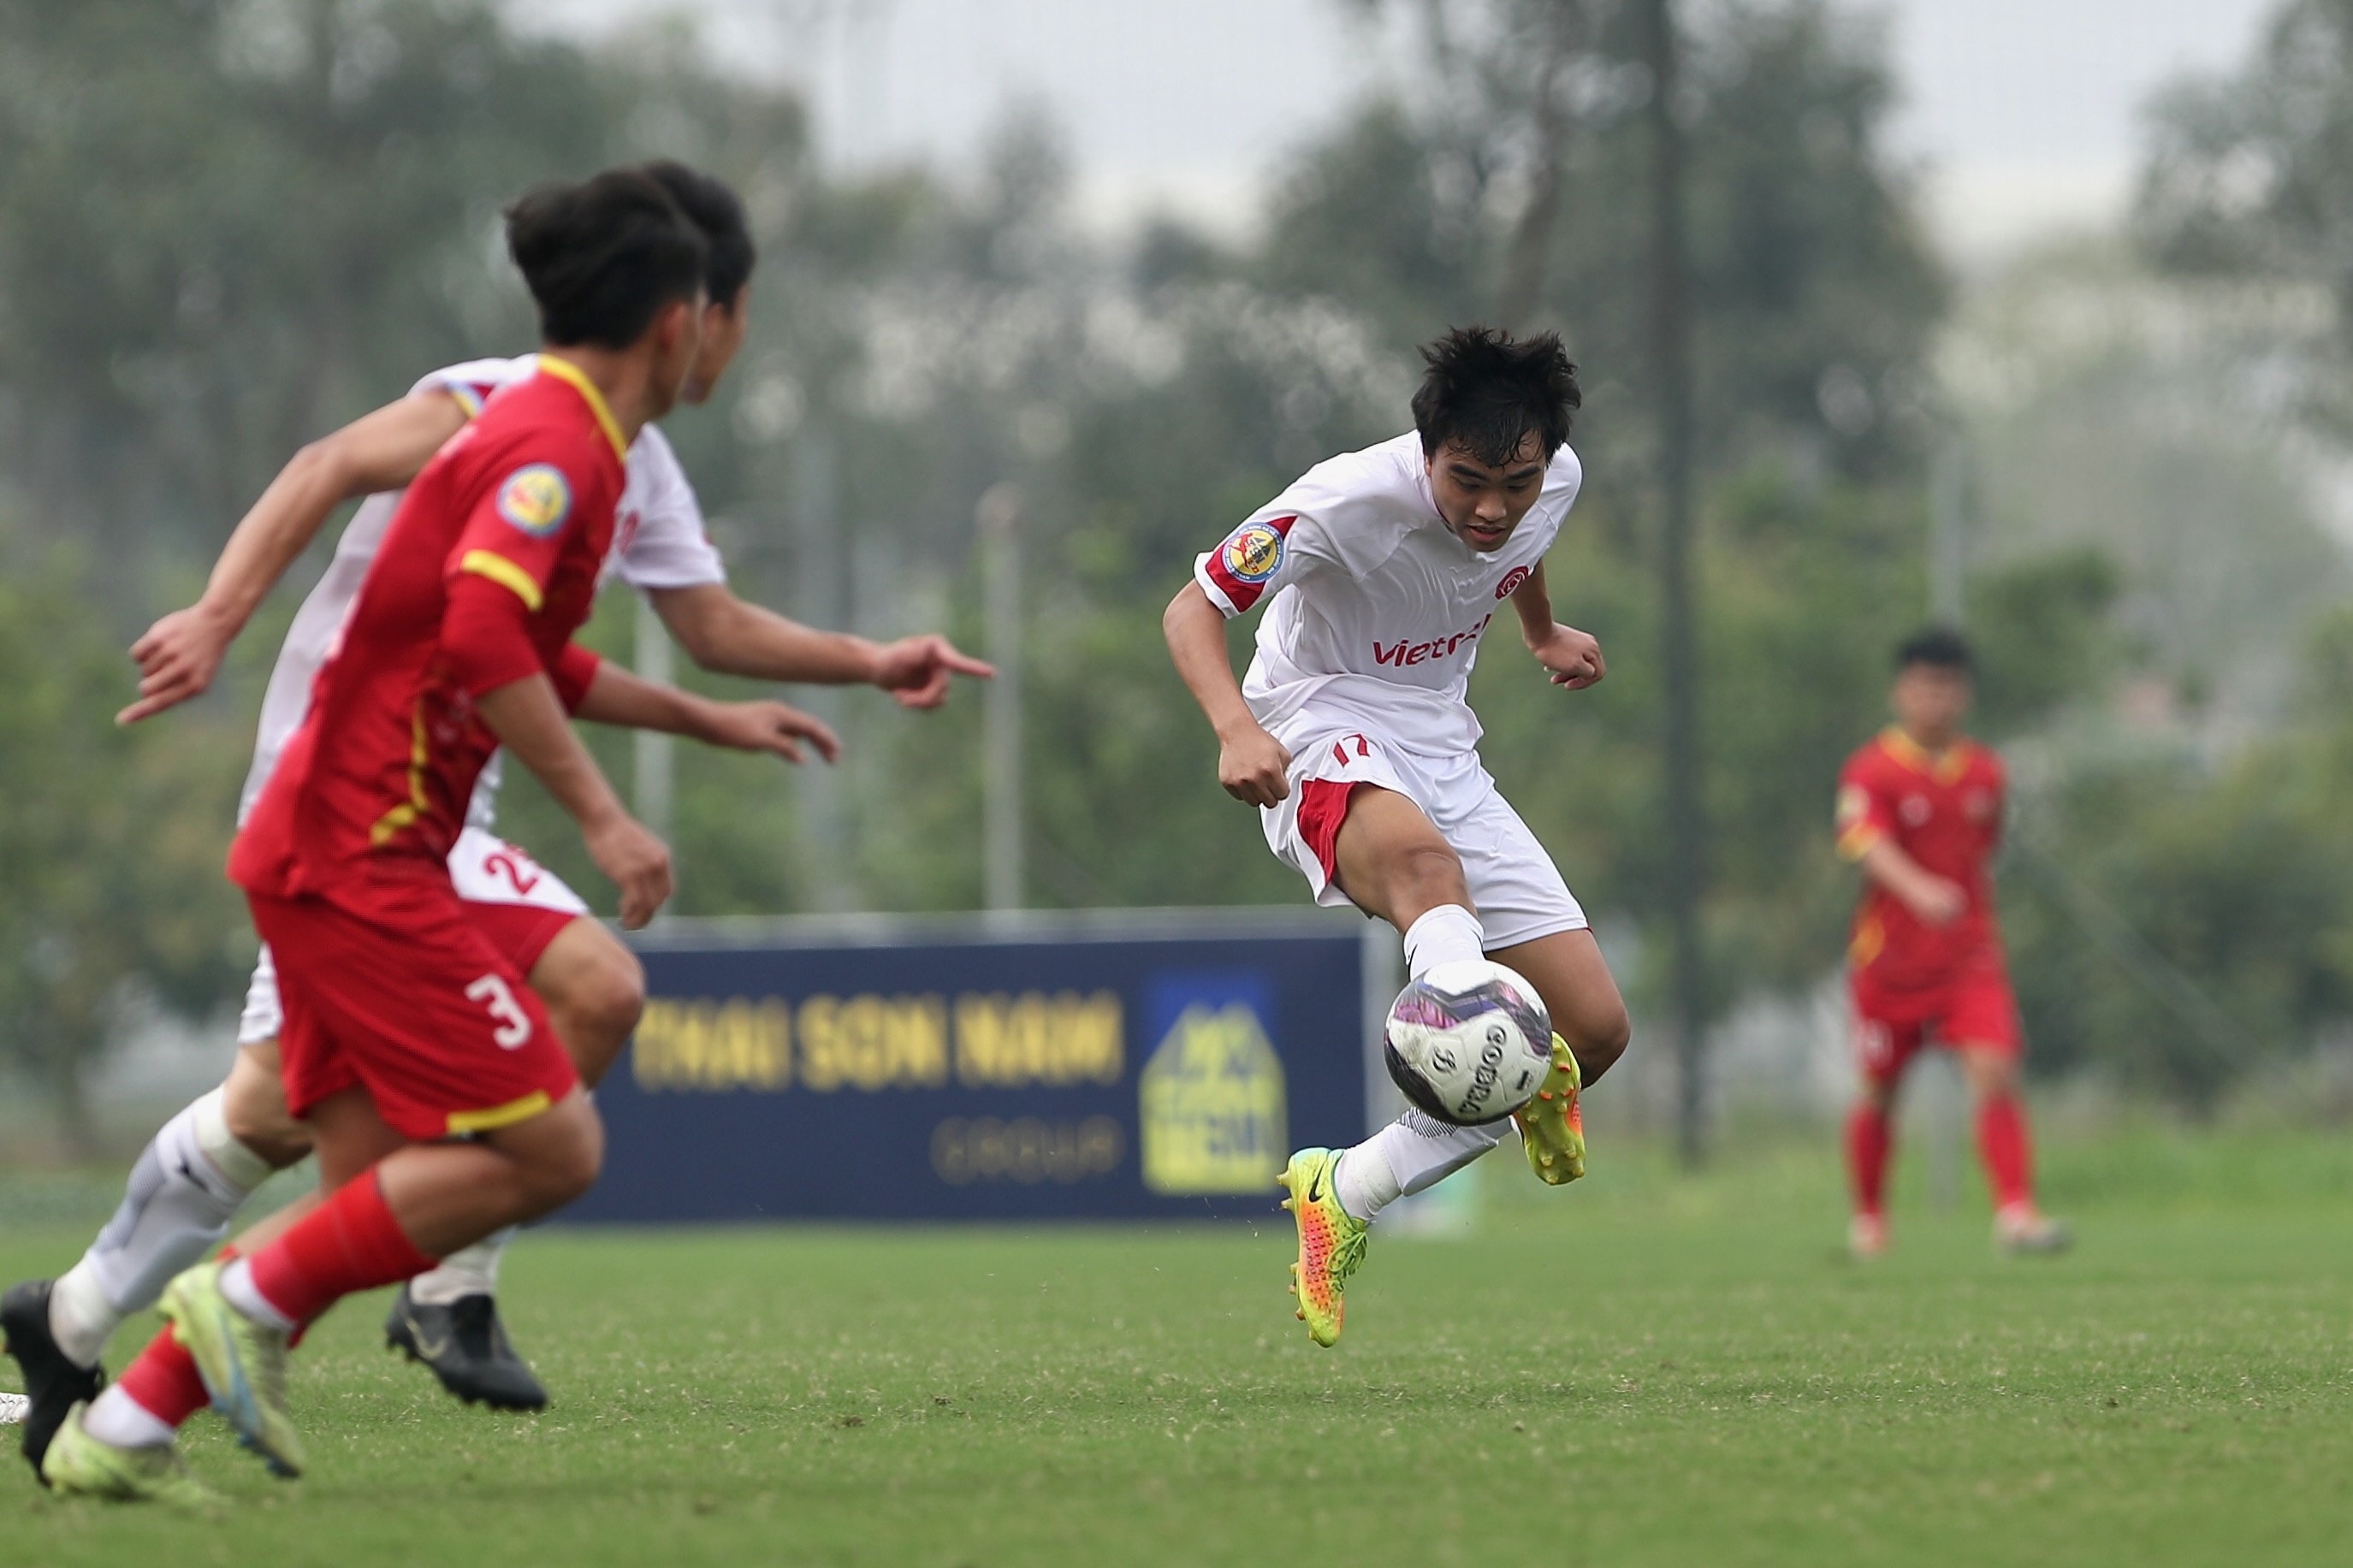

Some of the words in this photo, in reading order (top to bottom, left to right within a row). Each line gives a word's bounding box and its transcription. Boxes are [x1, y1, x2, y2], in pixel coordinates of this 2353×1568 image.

[1333, 733, 1371, 768] 17
[483, 842, 544, 896] 2
[463, 972, 533, 1052] 3
